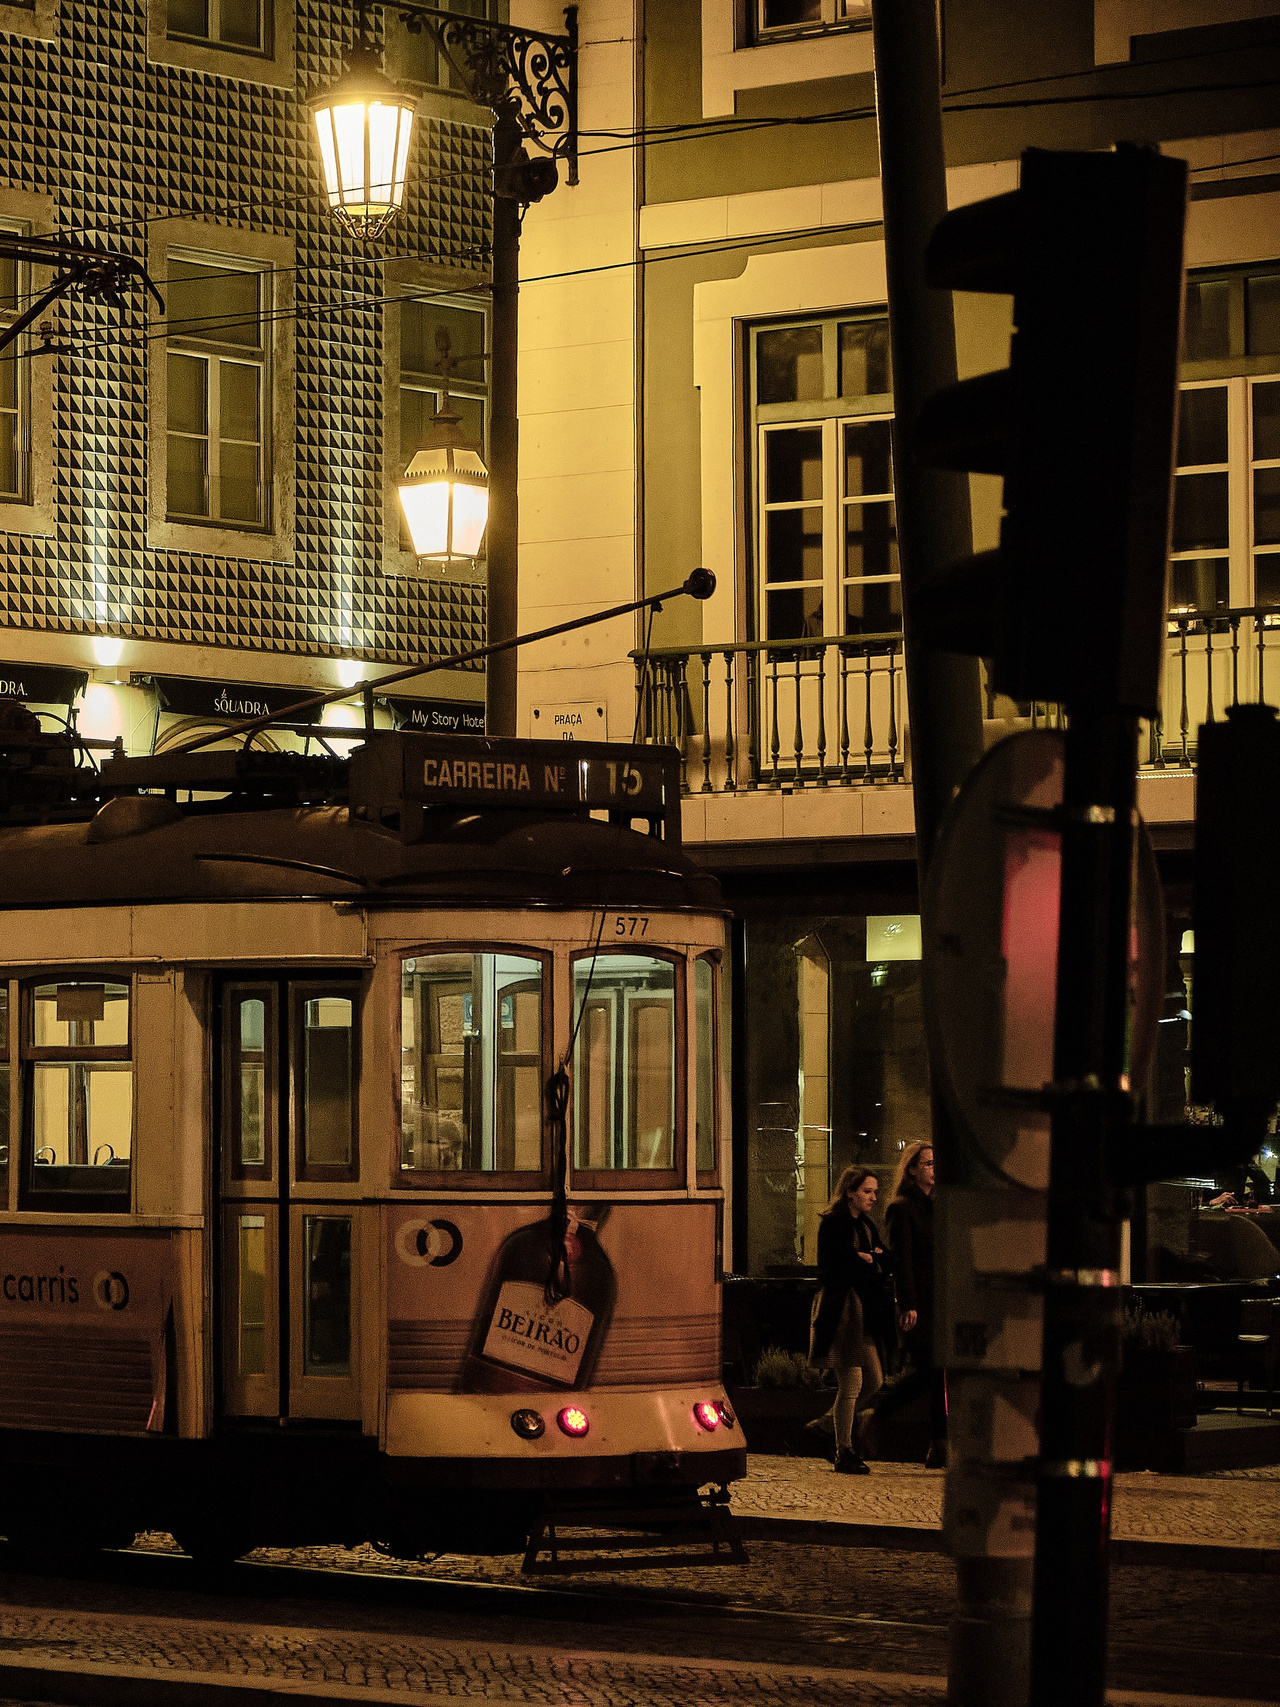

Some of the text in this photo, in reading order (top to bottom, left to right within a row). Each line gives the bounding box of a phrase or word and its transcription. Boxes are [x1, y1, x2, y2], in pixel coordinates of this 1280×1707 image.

[214, 698, 270, 715] SQUADRA
[411, 709, 429, 727] My
[432, 711, 460, 730] Story
[554, 714, 583, 727] PRAÇA
[423, 759, 531, 791] CARREIRA
[606, 761, 644, 796] 15
[616, 916, 650, 936] 577
[3, 1265, 80, 1304] carris
[497, 1307, 580, 1354] BEIRÃO
